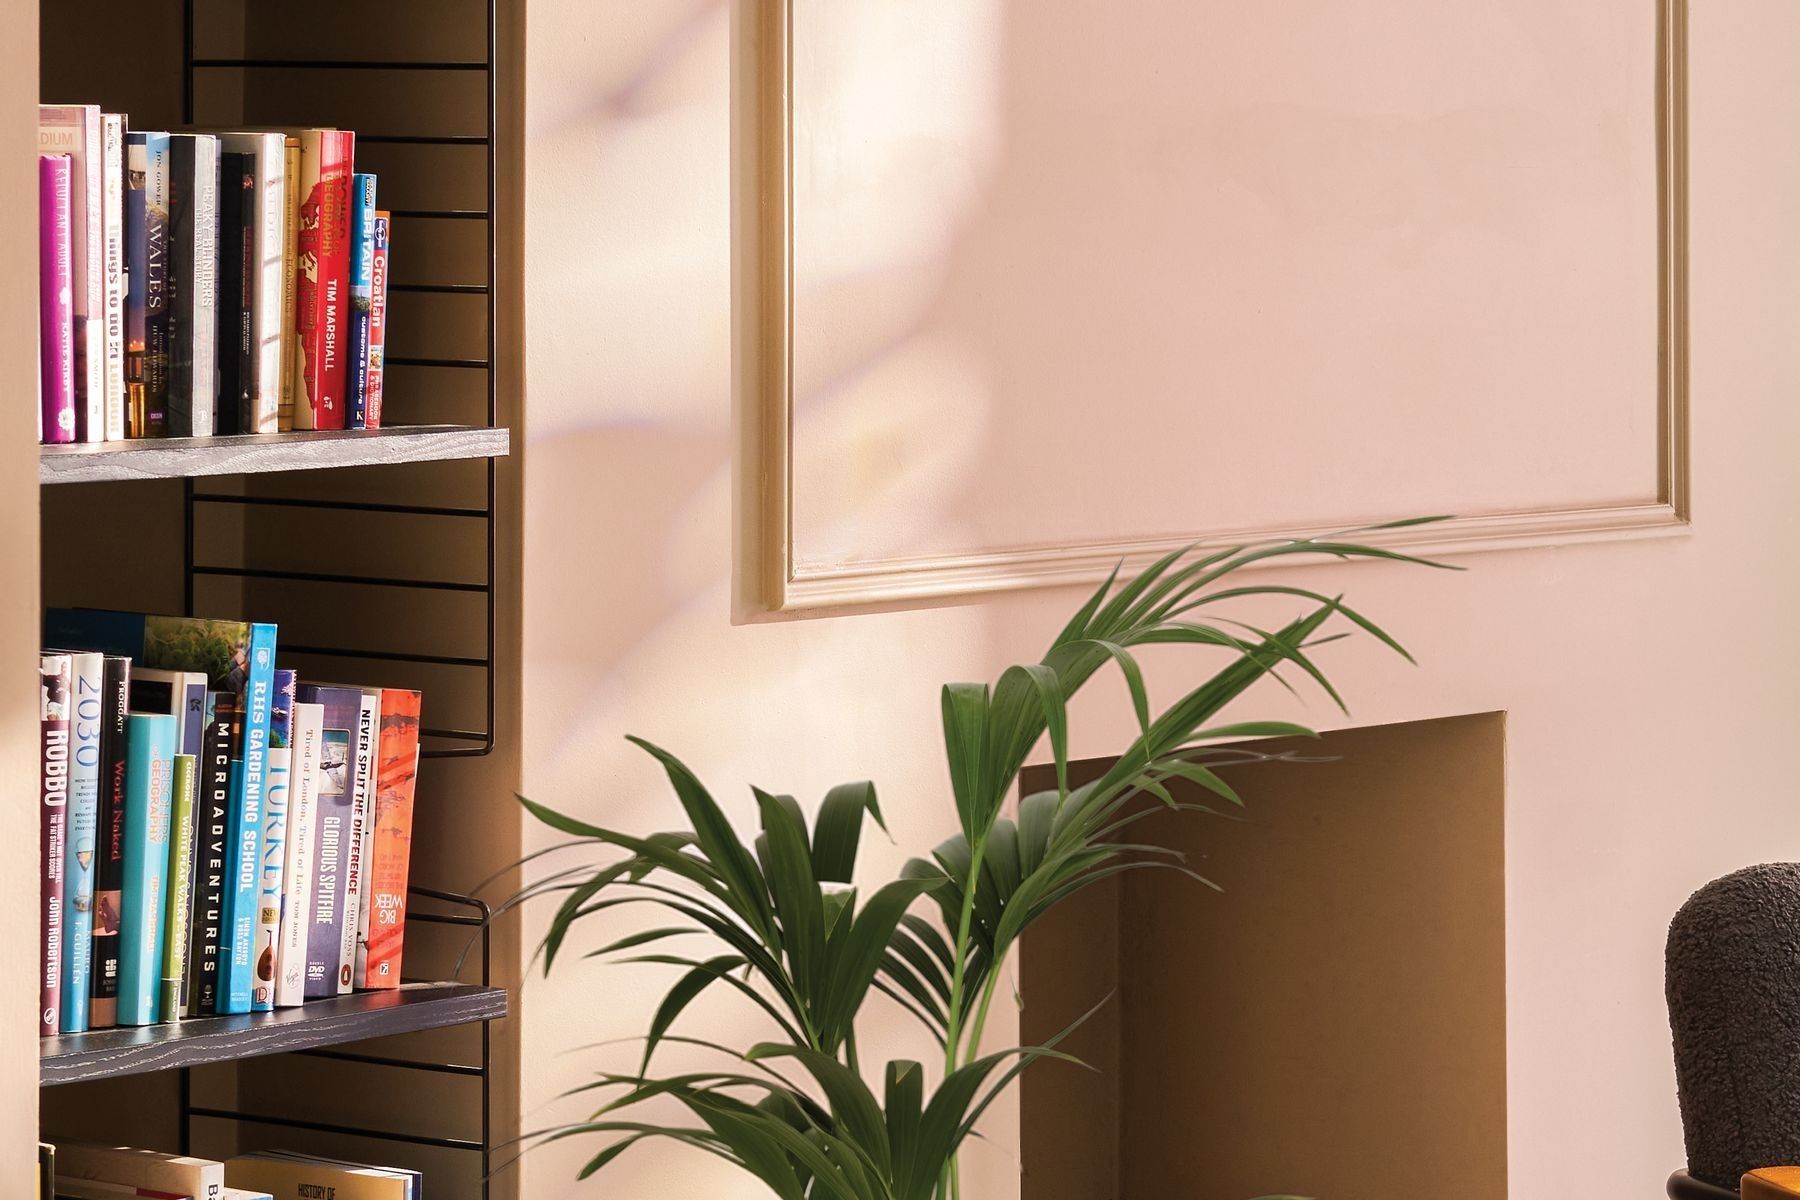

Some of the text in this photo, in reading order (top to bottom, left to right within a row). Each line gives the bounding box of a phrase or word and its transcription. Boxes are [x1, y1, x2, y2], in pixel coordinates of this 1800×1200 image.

[155, 170, 163, 207] GOWER
[202, 184, 215, 231] PEAKY
[194, 228, 203, 252] REAL
[322, 174, 335, 258] GEOGRAPHY
[148, 224, 163, 309] WALES
[361, 207, 374, 281] BRITAIN
[194, 255, 203, 284] STORY
[201, 237, 214, 307] BLINDERS
[371, 255, 386, 328] Croatian
[324, 278, 338, 372] TIM MARSHALL
[357, 368, 366, 405] culture
[76, 674, 101, 768] 2030
[116, 680, 127, 735] FROGGATT
[44, 729, 69, 807] ROBBO
[301, 762, 312, 774] of
[303, 729, 315, 759] Tired
[111, 759, 126, 863] Work Naked
[149, 758, 162, 843] GEOGRAPHY
[239, 680, 268, 893] RHS GARDENING SCHOOL
[298, 777, 311, 822] London,
[347, 708, 372, 896] NEVER SPLIT THE DIFFERENCE
[49, 836, 57, 859] STRIKER
[203, 722, 230, 972] MICROADVENTURES
[263, 765, 289, 900] TURKEY
[297, 825, 308, 855] Tired
[48, 859, 56, 879] SCORES
[173, 815, 190, 961] WHITE PEAK WALKS EAST
[294, 873, 305, 895] Life
[316, 816, 341, 925] GLORIOUS SPITFIRE
[293, 900, 301, 919] TOM
[348, 902, 356, 931] CHRIS
[374, 893, 403, 909] WEEK
[379, 909, 397, 925] BIG
[45, 896, 61, 988] John Robertson
[72, 933, 82, 985] GUILLÉN
[241, 916, 251, 966] SIMON AKEROYD
[291, 921, 300, 948] JONES
[346, 933, 354, 958] VOSS
[298, 1183, 336, 1200] HISTORY OF
